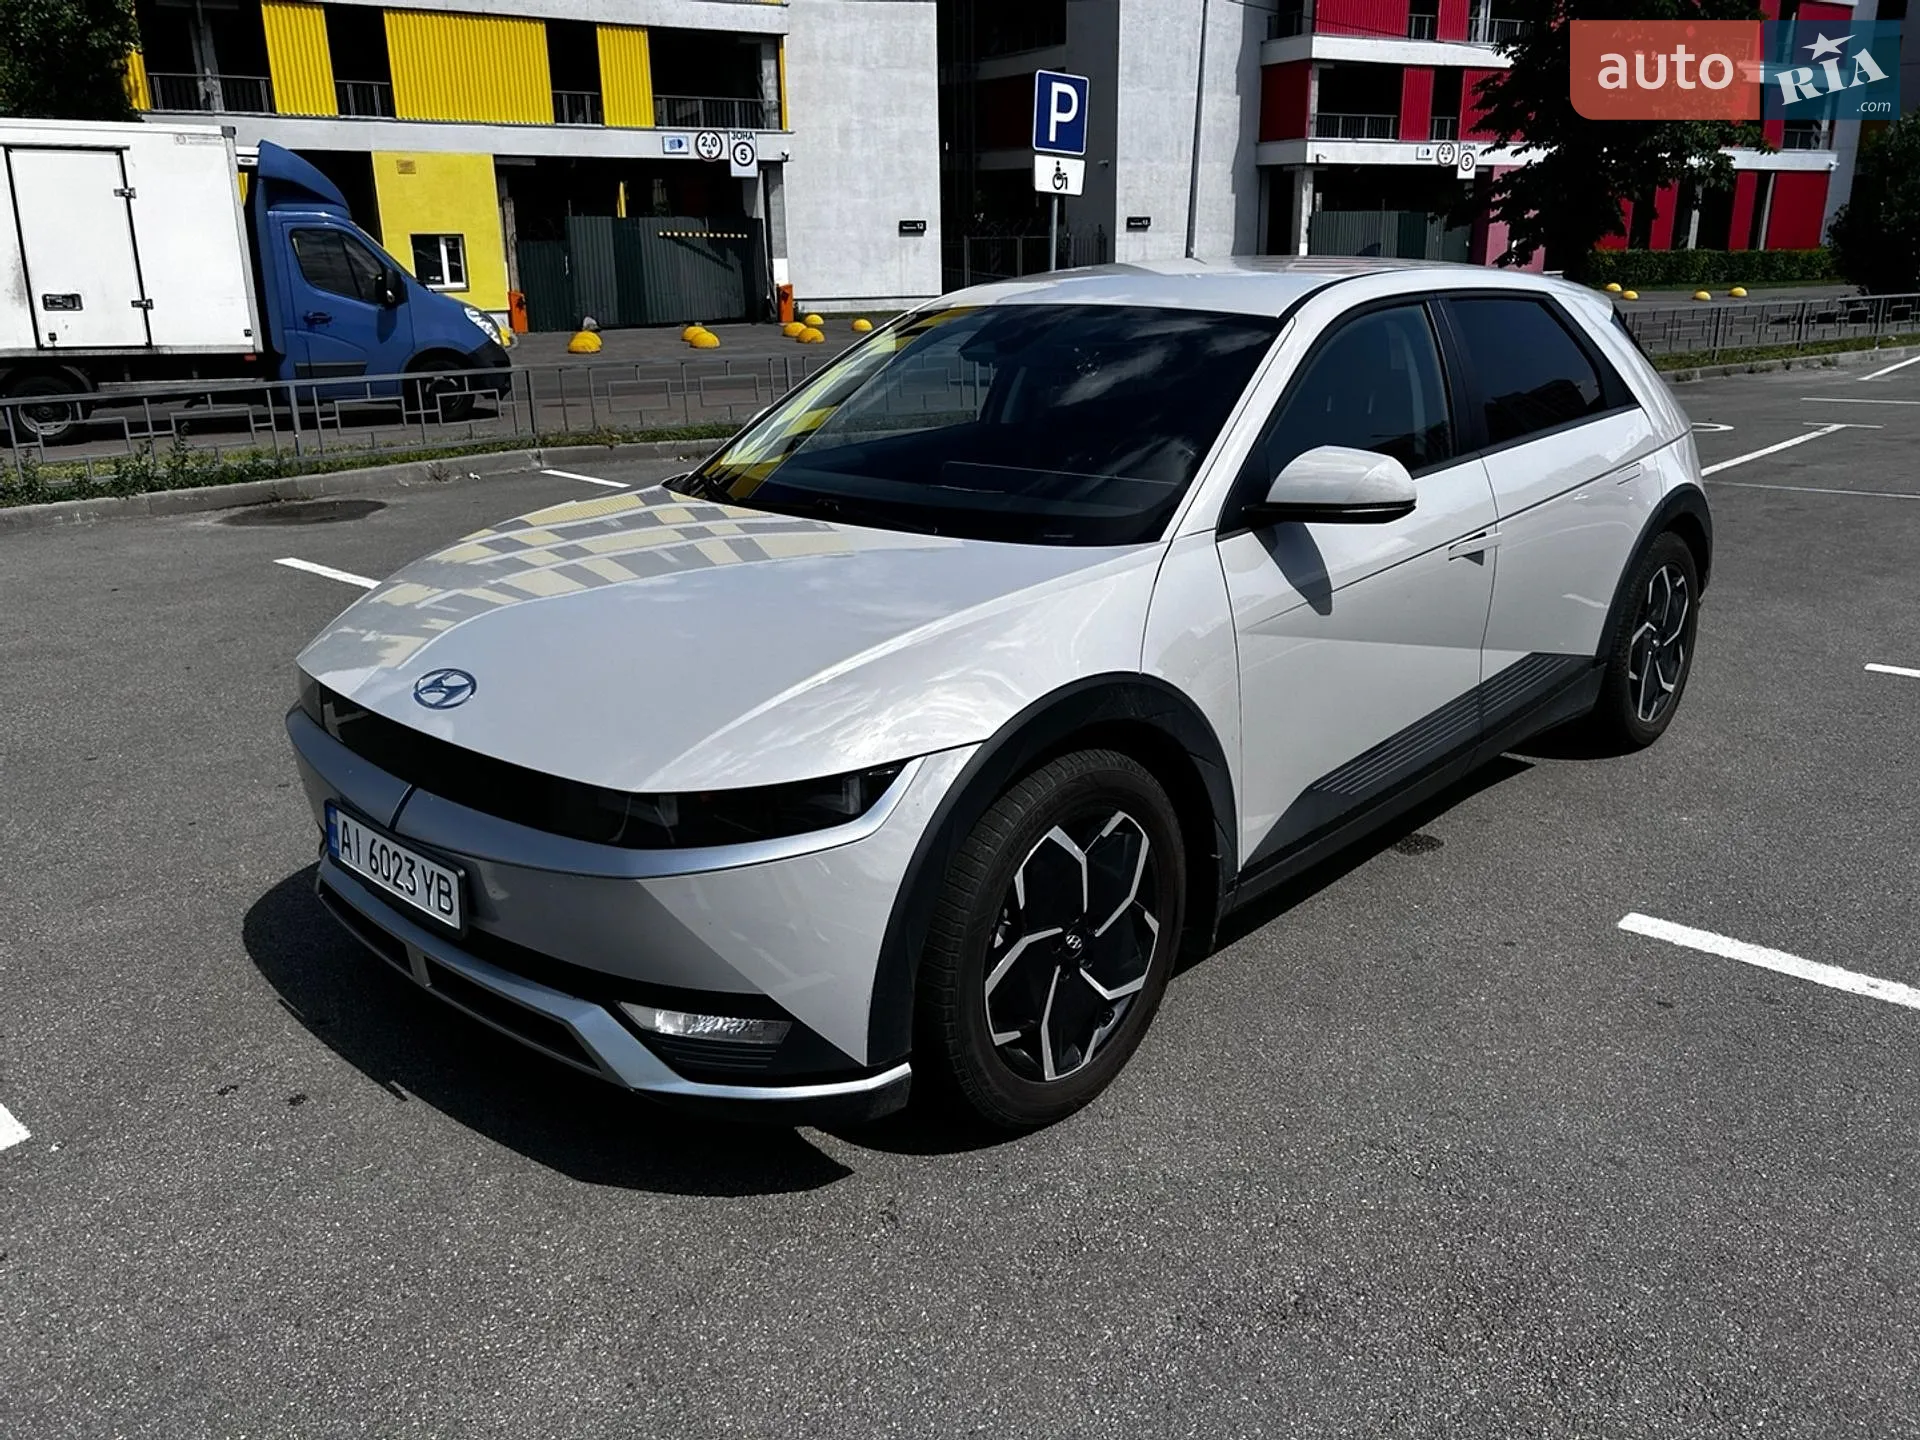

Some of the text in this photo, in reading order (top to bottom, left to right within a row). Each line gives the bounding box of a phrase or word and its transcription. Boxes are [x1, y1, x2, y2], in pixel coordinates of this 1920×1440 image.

[1049, 81, 1079, 142] P
[731, 131, 754, 140] ЗОНА
[740, 149, 747, 161] 5
[341, 820, 454, 916] AI 6023 YB
